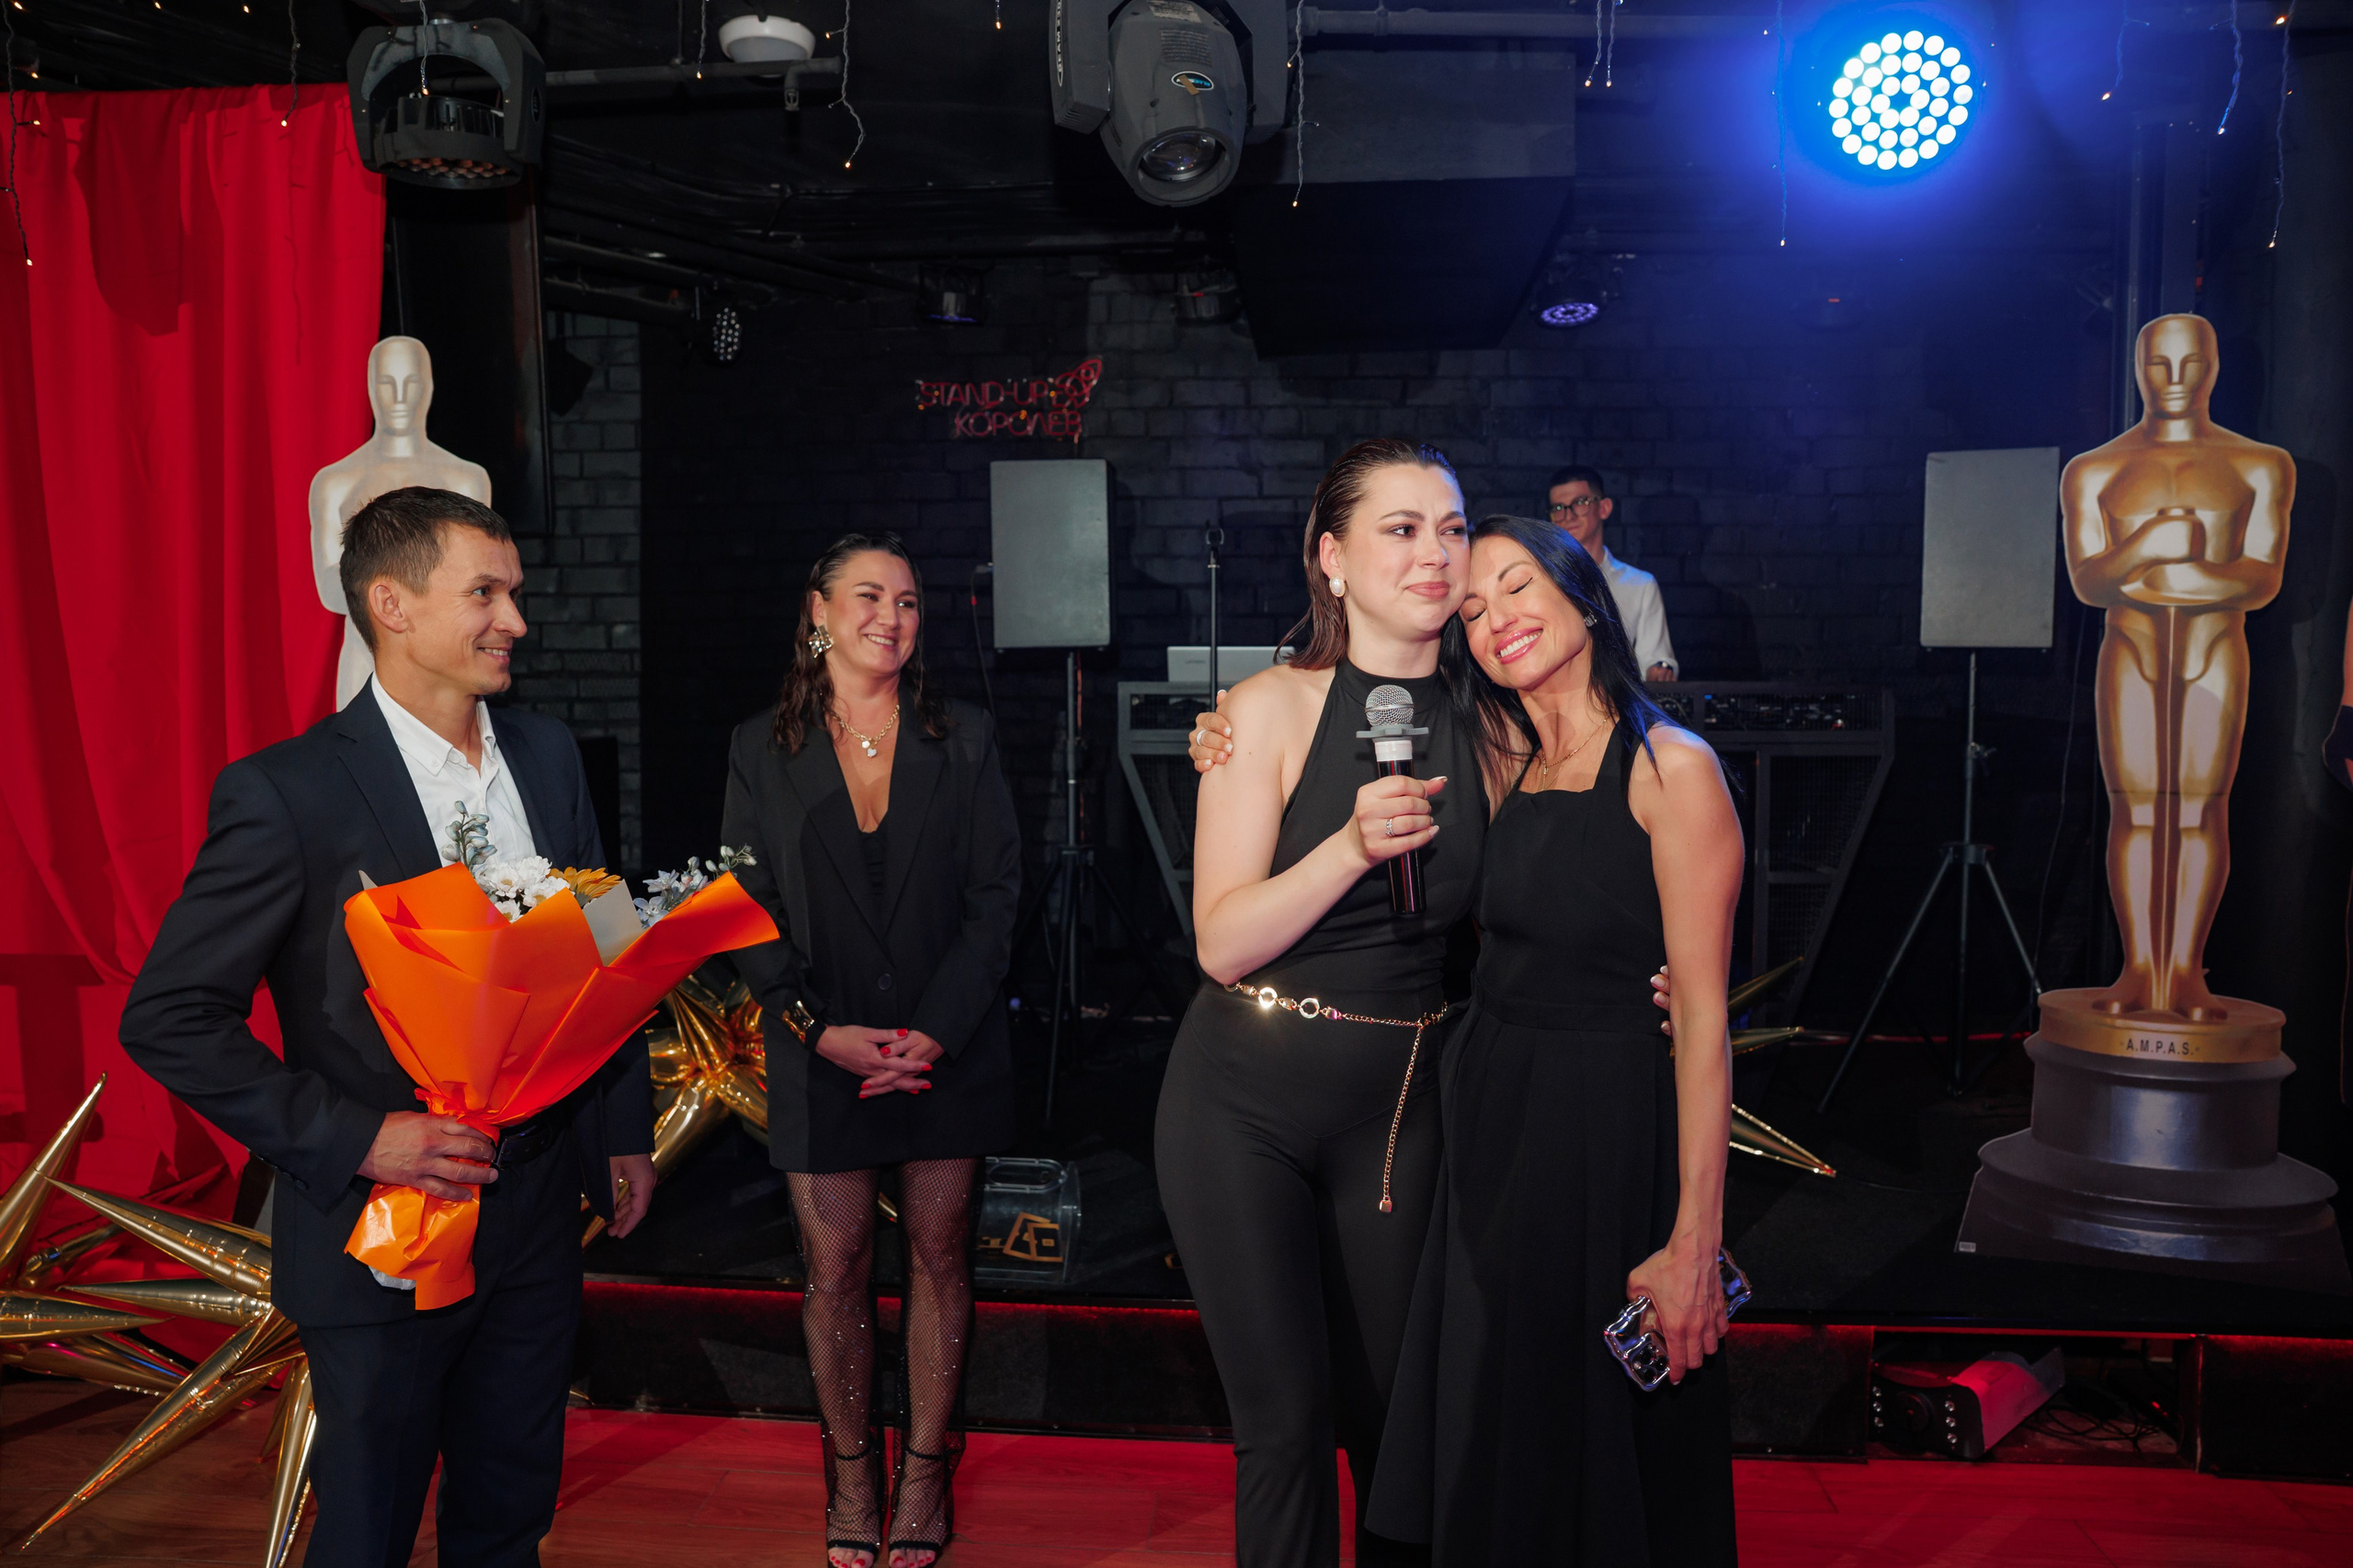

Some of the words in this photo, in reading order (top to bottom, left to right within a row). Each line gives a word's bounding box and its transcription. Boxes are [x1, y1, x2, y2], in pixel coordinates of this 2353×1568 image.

[919, 381, 1049, 407] STAND-UP
[954, 411, 1082, 437] КОРОЛЕВ
[2126, 1038, 2194, 1055] A.M.P.A.S.
